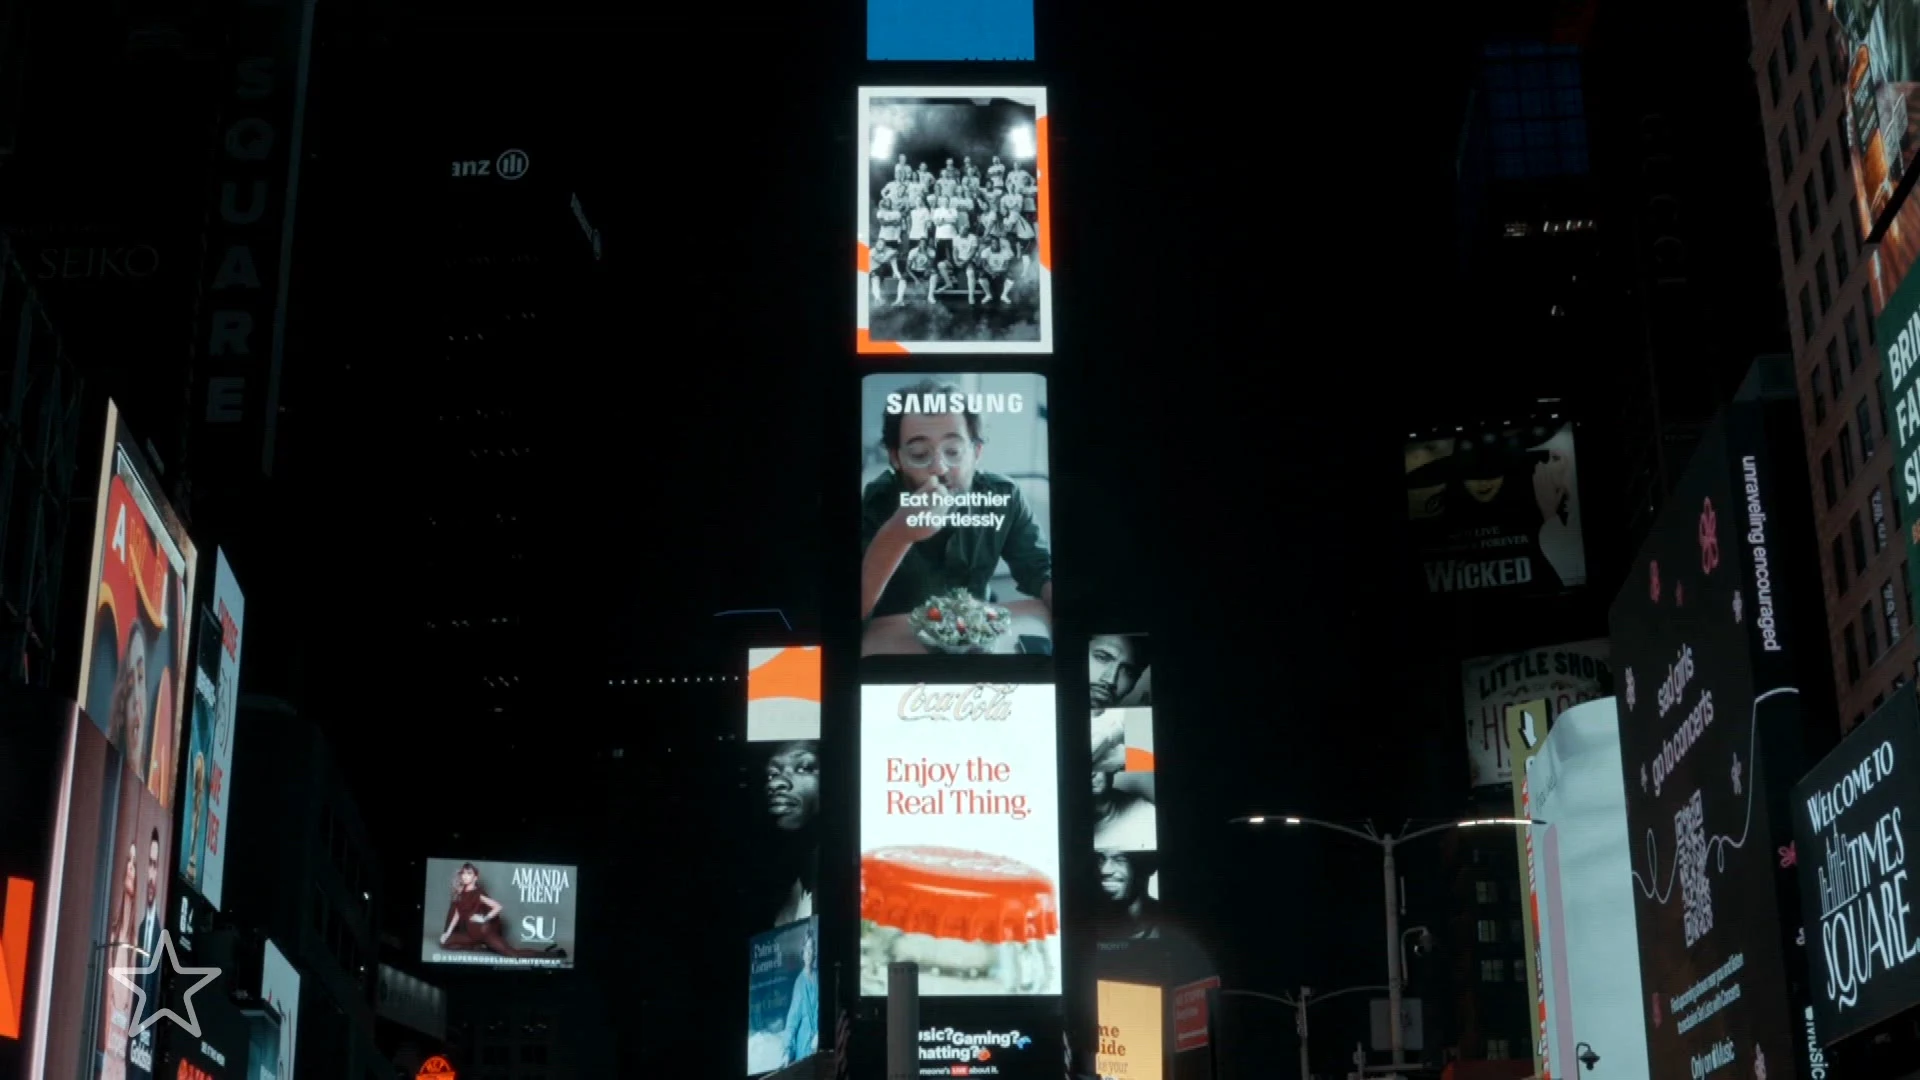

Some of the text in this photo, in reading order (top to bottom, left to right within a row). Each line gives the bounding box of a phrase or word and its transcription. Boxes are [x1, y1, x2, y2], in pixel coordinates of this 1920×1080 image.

[206, 56, 276, 423] SQUARE
[37, 245, 160, 278] SEIKO
[887, 393, 1023, 414] SAMSUNG
[900, 491, 1011, 507] Eat healthier
[906, 512, 1006, 531] effortlessly
[1741, 456, 1782, 652] unraveling encouraged
[1479, 651, 1549, 699] LITTLE
[1673, 688, 1714, 763] concerts
[887, 757, 1010, 788] Enjoy the
[1807, 741, 1894, 835] WELCOME TO
[887, 789, 1032, 820] Real Thing.
[1847, 807, 1905, 893] TIMES
[512, 867, 570, 888] AMANDA
[519, 885, 561, 904] TRENT
[520, 915, 556, 943] SU
[1823, 869, 1918, 1014] SQUARE
[918, 1044, 979, 1062] hatting?
[952, 1030, 1020, 1049] Gaming?
